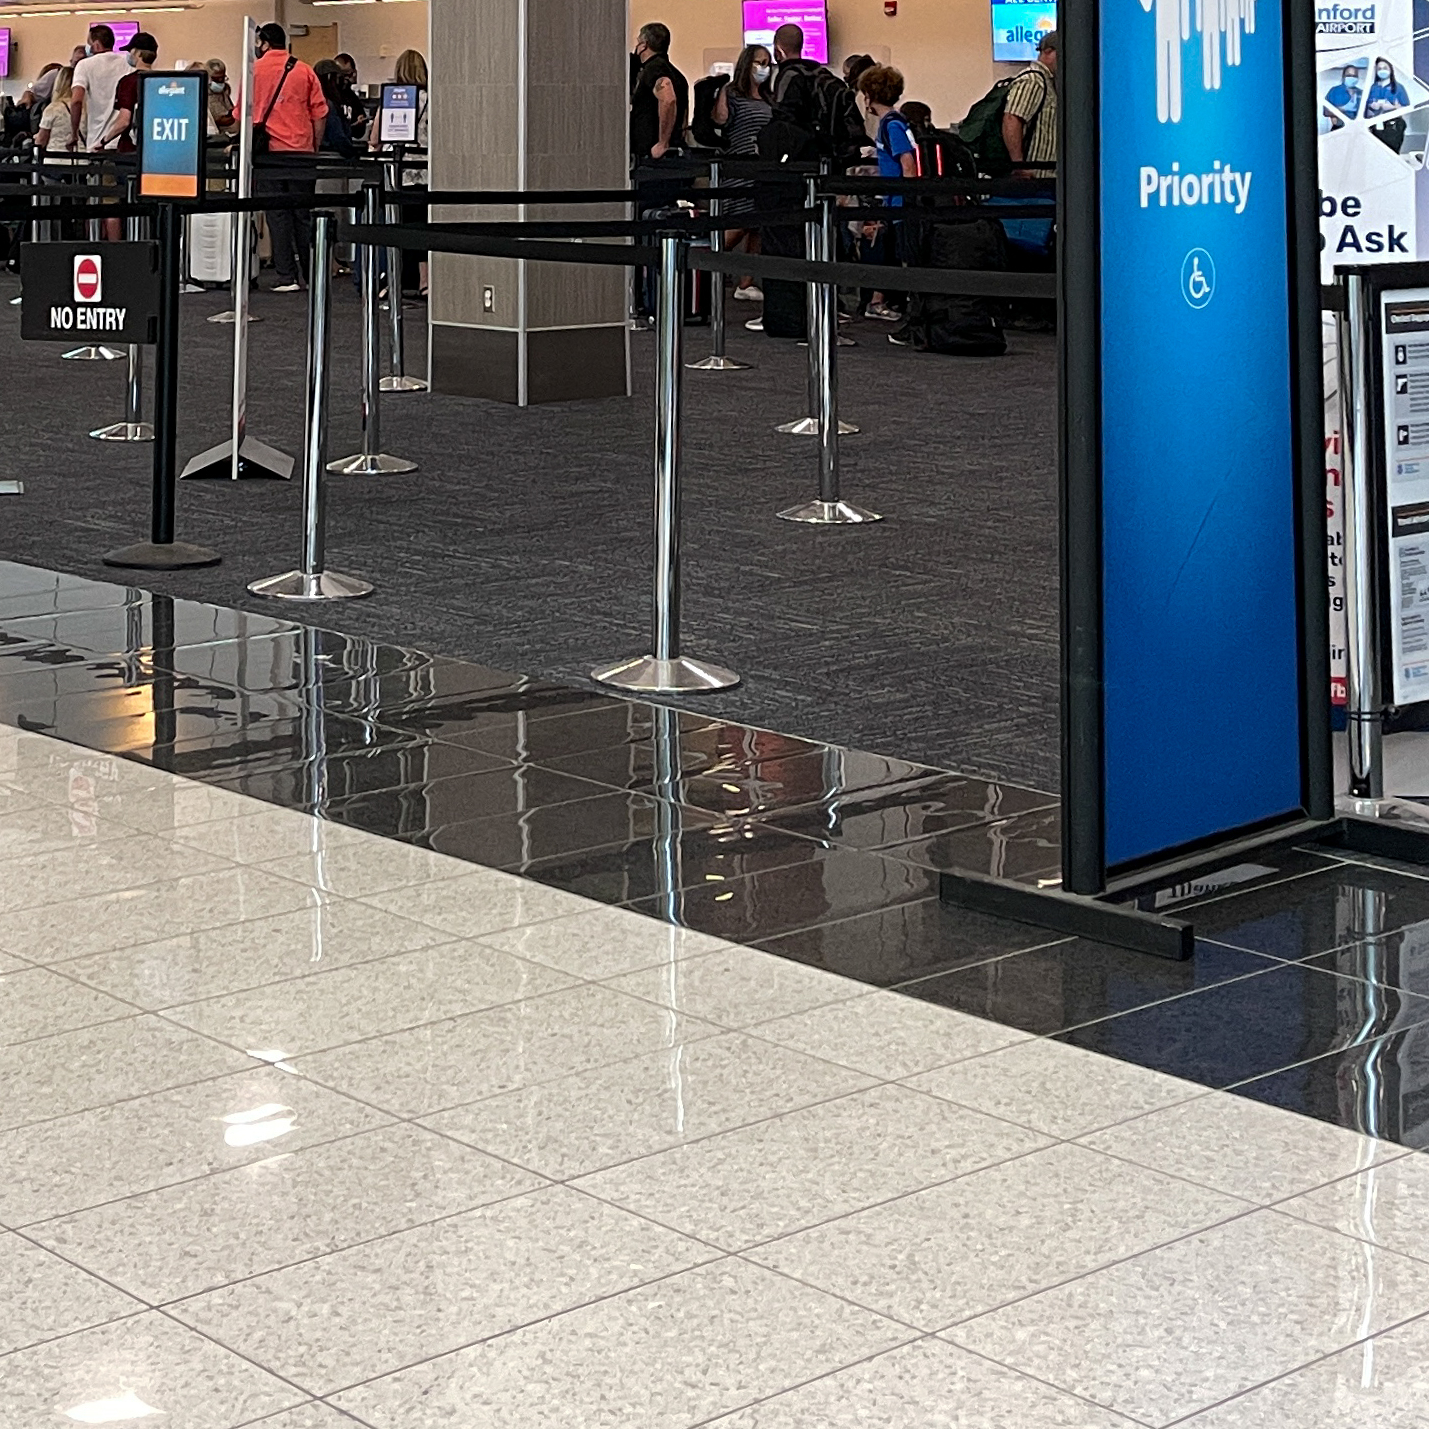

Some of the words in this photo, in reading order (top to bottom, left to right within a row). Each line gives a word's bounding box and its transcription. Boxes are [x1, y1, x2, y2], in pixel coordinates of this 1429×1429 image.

[1316, 22, 1373, 33] AIRPORT
[152, 118, 189, 141] EXIT
[1139, 160, 1252, 214] Priority
[1336, 224, 1409, 253] Ask
[50, 306, 73, 329] NO
[76, 307, 126, 330] ENTRY
